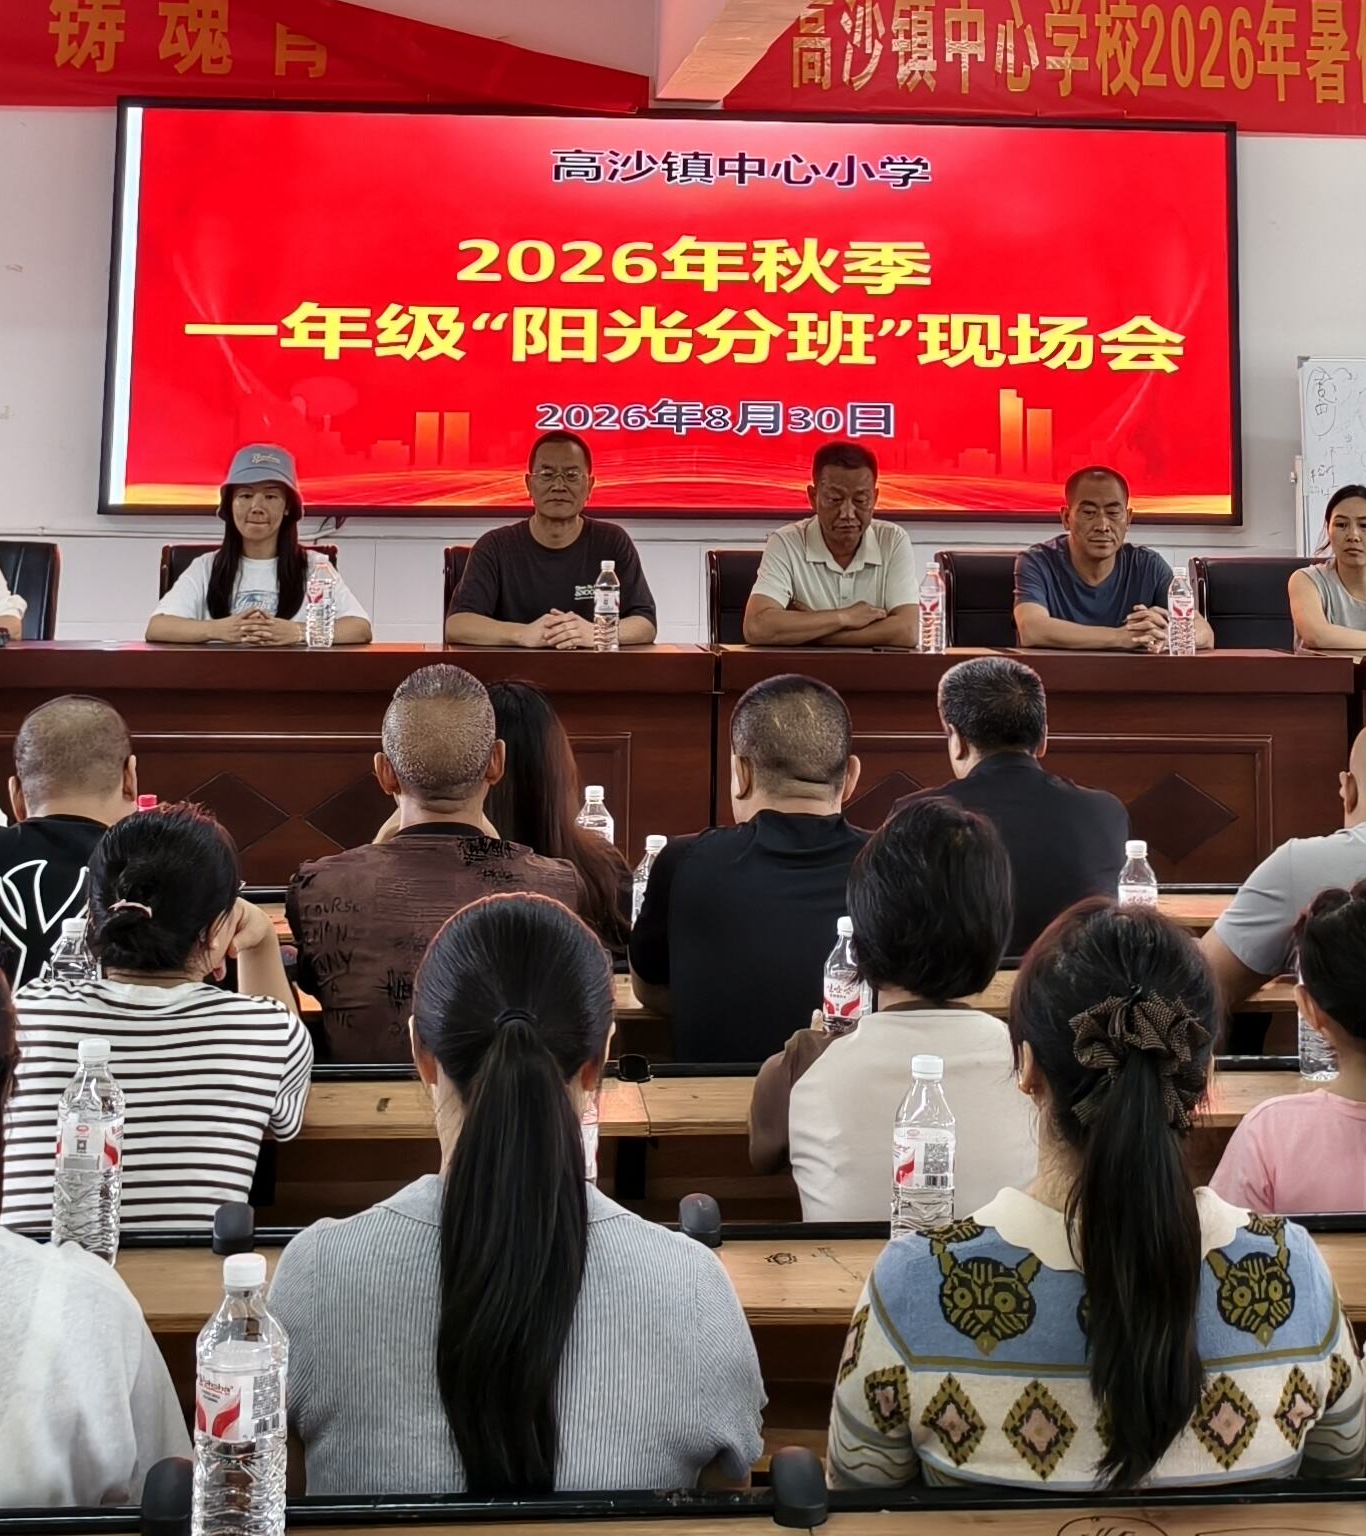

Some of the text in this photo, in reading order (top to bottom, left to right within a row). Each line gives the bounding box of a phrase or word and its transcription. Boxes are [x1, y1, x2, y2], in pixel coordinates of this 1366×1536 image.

[550, 148, 932, 189] 高沙镇中心小学
[455, 235, 933, 295] 2026年秋季
[184, 301, 1185, 373] 一年级“阳光分班”现场会
[535, 398, 895, 437] 2026年8月30日
